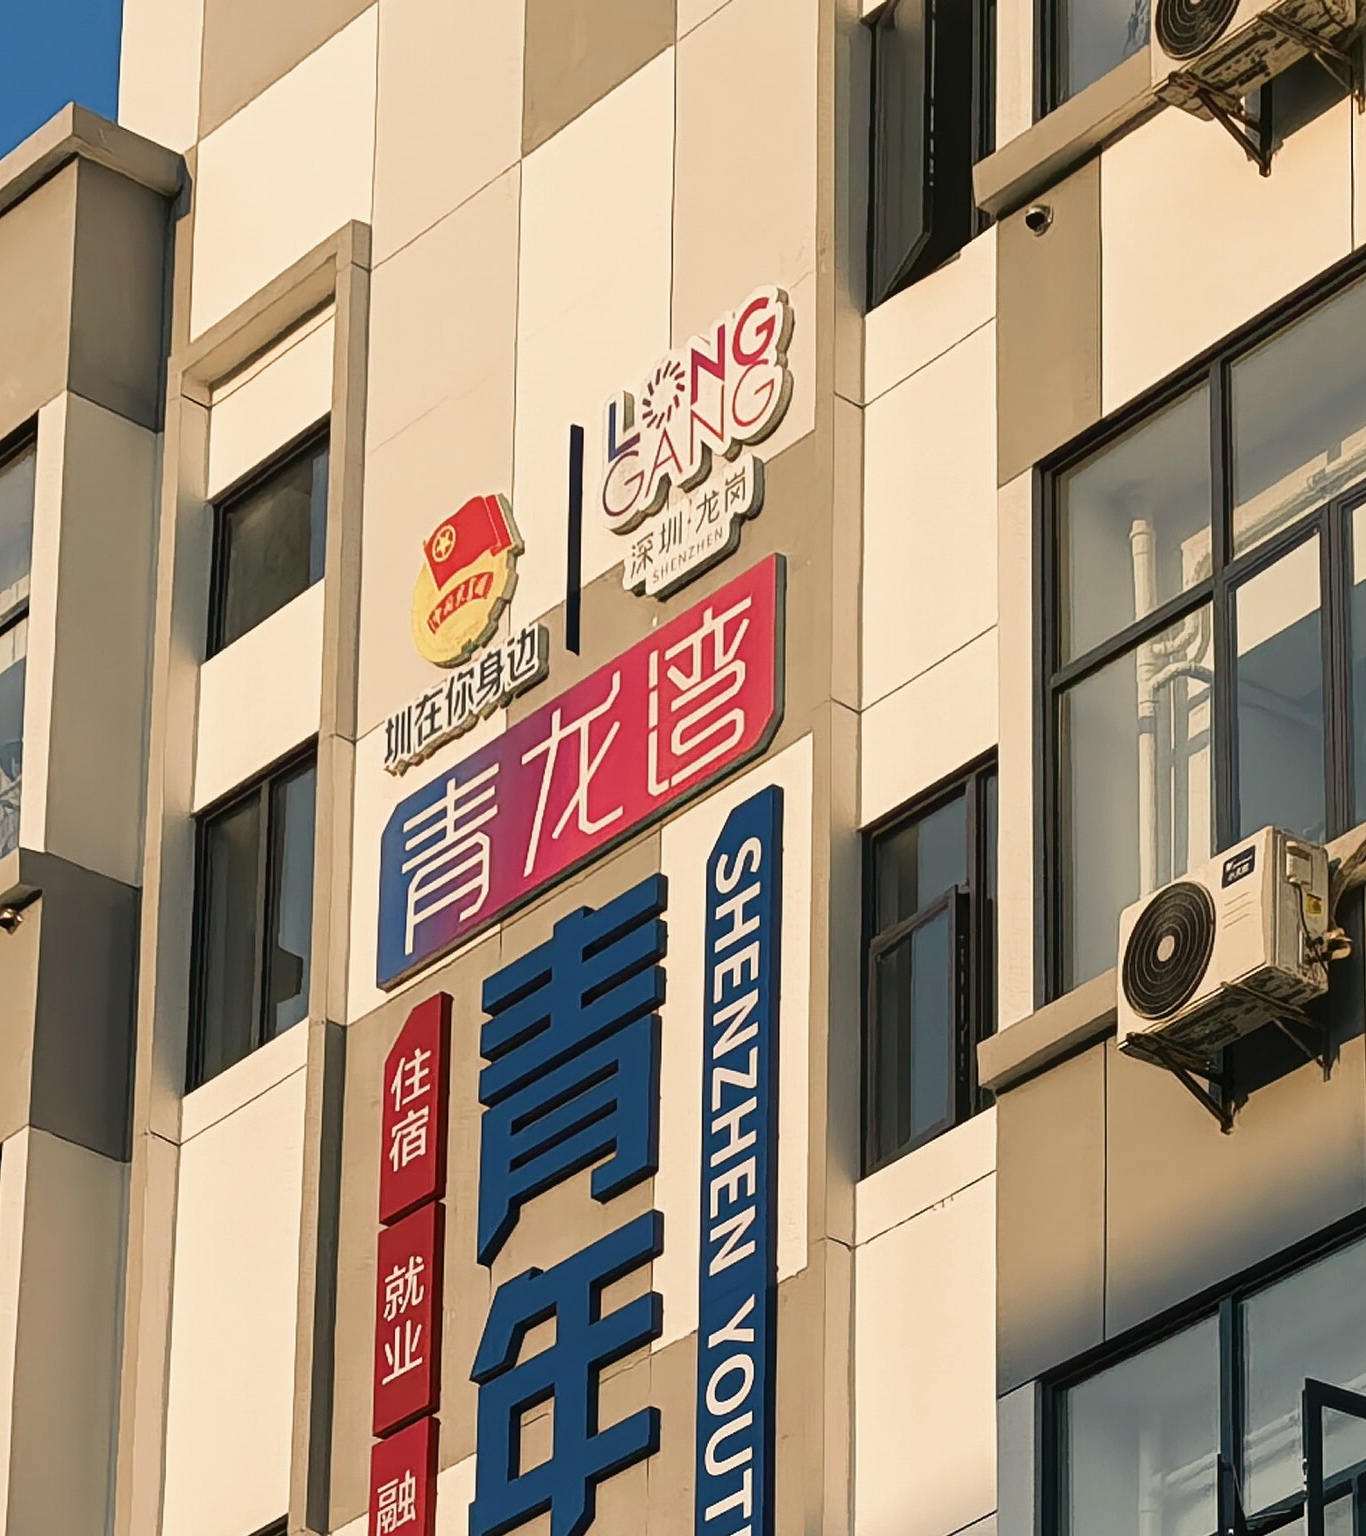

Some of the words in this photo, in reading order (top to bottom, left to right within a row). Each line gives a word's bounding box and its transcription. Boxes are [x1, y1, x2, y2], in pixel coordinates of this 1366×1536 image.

[603, 359, 775, 517] GANG
[652, 526, 723, 584] SHENZHEN
[384, 627, 538, 764] 圳在你身边
[402, 596, 752, 955] 青龙湾
[388, 1047, 431, 1172] 住宿
[708, 836, 762, 1277] SHENZHEN
[382, 1255, 425, 1385] 就业
